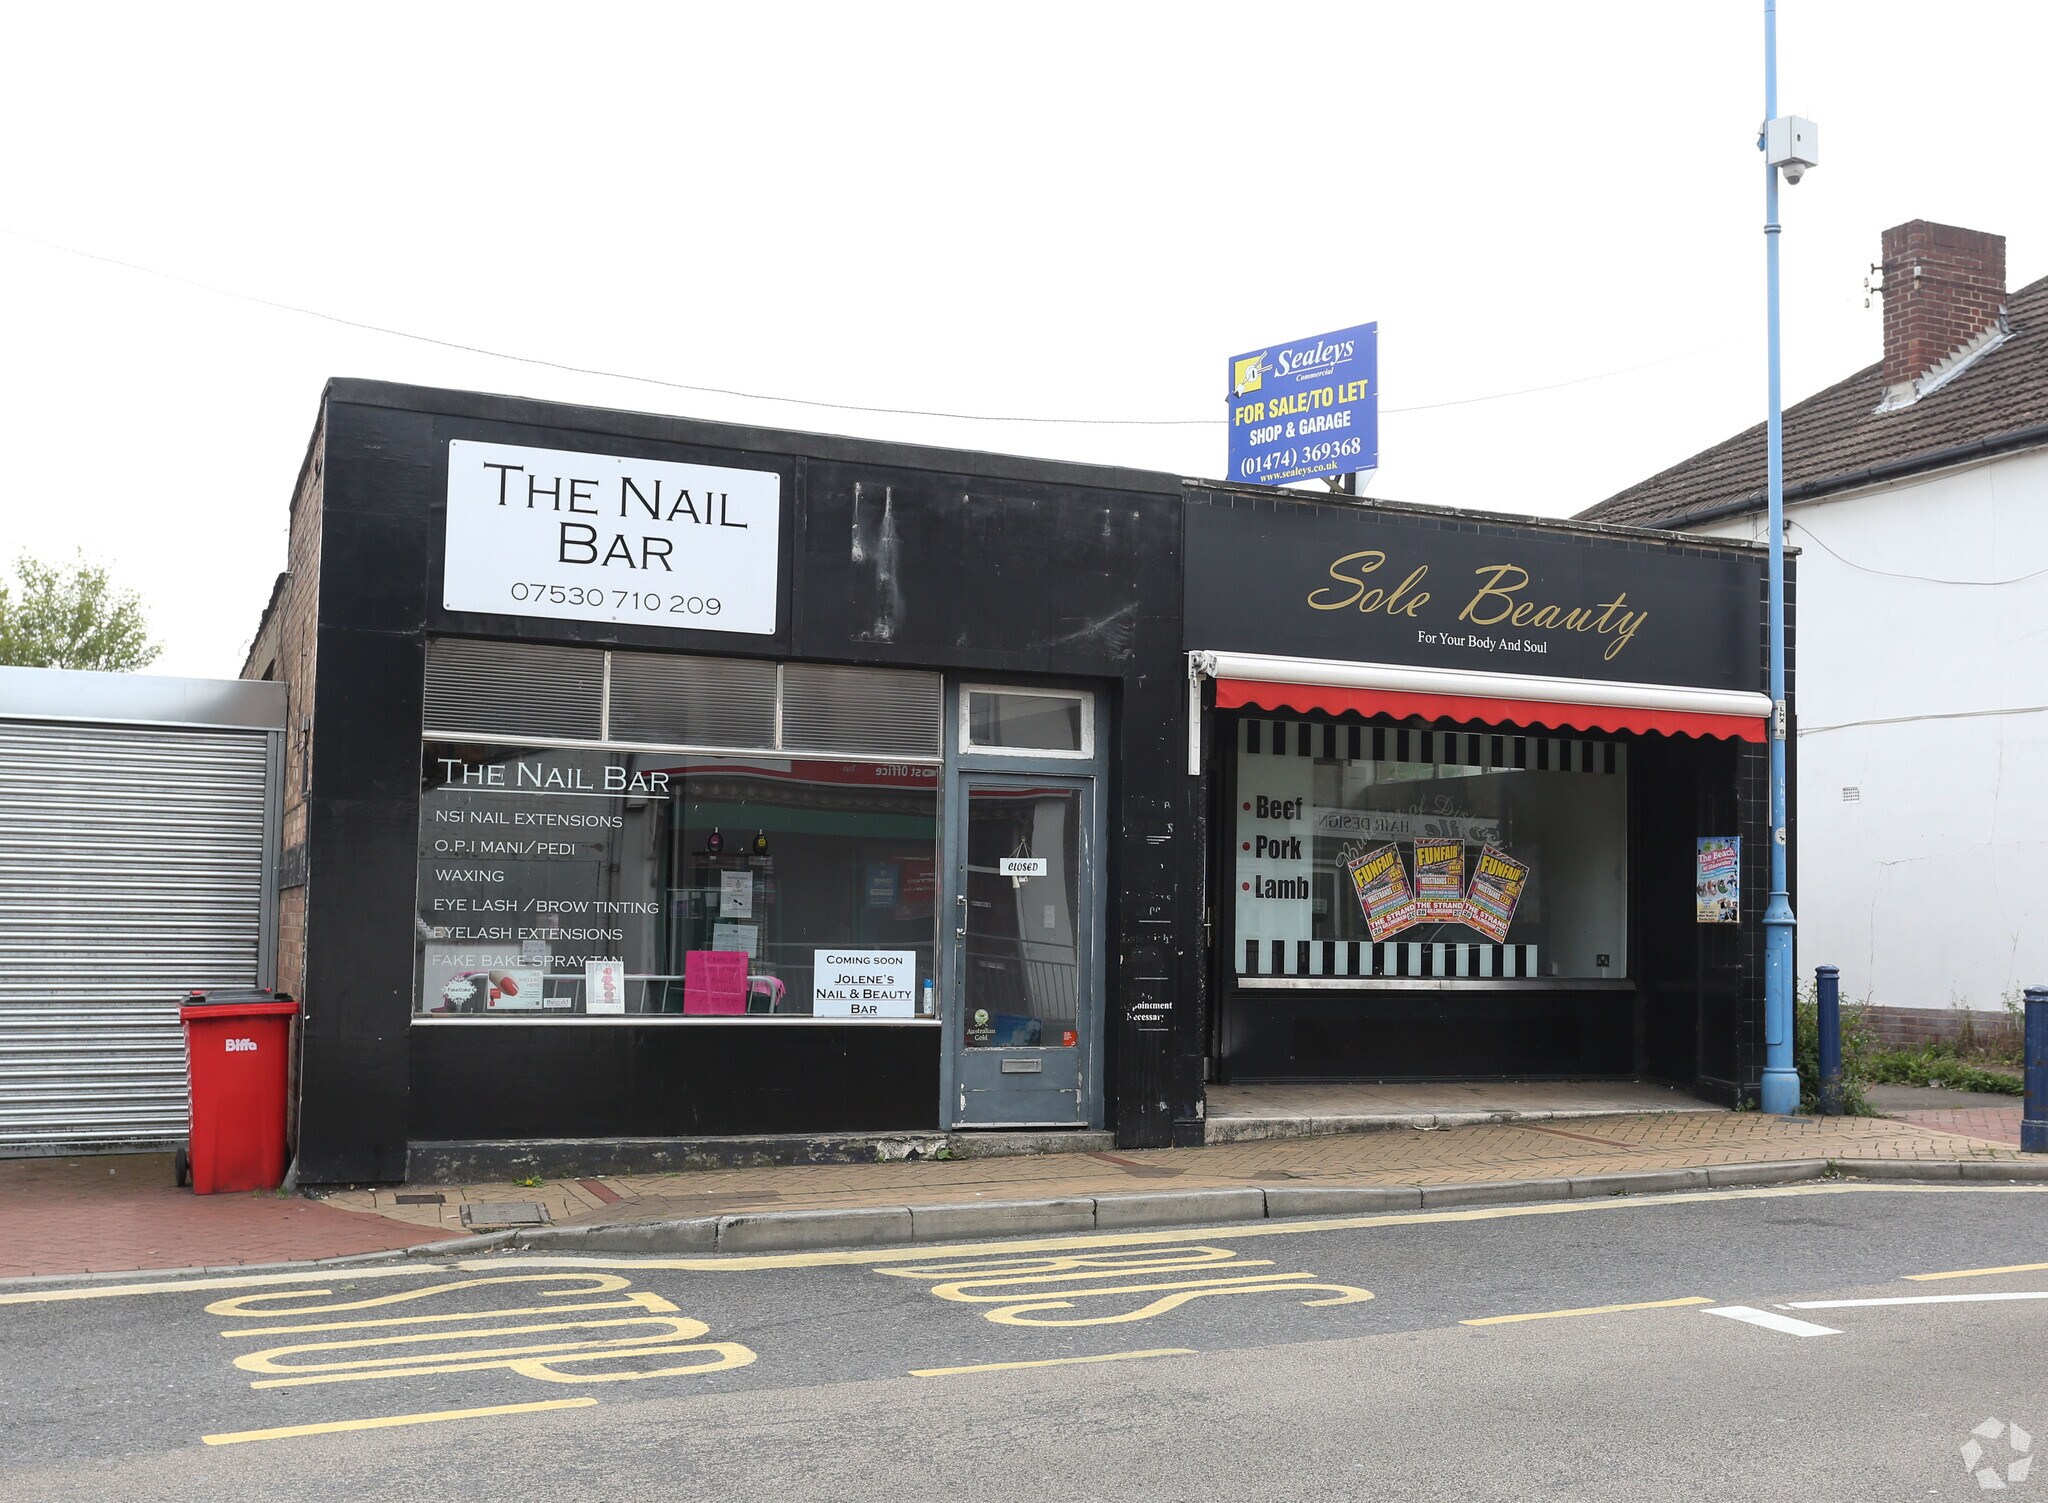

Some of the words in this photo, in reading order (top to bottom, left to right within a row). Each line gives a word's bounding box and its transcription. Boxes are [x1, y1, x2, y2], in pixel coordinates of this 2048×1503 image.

[1273, 340, 1355, 378] Sealeys
[1296, 367, 1334, 382] Commercial
[1235, 402, 1265, 427] FOR
[1269, 387, 1334, 418] SALE/TO
[1338, 379, 1368, 404] LET
[1249, 424, 1283, 446] SHOP
[1285, 421, 1296, 439] &
[1299, 410, 1352, 436] GARAGE
[1240, 448, 1297, 478] (01474)
[1301, 437, 1361, 464] 369368
[1260, 460, 1338, 483] www.sealeys.co.uk
[483, 461, 600, 516] THE
[619, 476, 748, 530] NAIL
[558, 521, 674, 572] BAR
[511, 582, 604, 607] 07530
[611, 589, 661, 611] 710
[669, 594, 721, 616] 209
[1307, 550, 1431, 617] Sole
[1458, 563, 1648, 661] Beauty
[1418, 630, 1437, 644] For
[1440, 632, 1465, 646] Your
[1468, 635, 1497, 652] Body
[1498, 638, 1521, 651] And
[1523, 640, 1547, 653] Soul
[437, 757, 506, 786] THE
[517, 761, 594, 790] NAIL
[603, 765, 669, 793] BAR
[435, 810, 464, 823] NSI
[470, 811, 510, 825] NAIL
[514, 812, 623, 828] EXTENSIONS
[1256, 795, 1303, 820] Beef
[434, 839, 475, 852] O.P.I
[480, 840, 575, 855] MANI/PEDI
[1256, 834, 1302, 859] Pork
[1416, 845, 1458, 866] FUNFAIR
[1698, 853, 1712, 863] The
[1713, 847, 1735, 860] Beach
[435, 869, 505, 882] WAXING
[1007, 862, 1039, 872] CLOSED
[1354, 852, 1394, 888] FUNFAIR
[1480, 855, 1521, 880] FUNFAIR
[1255, 874, 1309, 900] Lamb
[434, 898, 467, 911] EYE
[472, 899, 517, 912] LASH
[593, 901, 659, 914] TINTING
[1370, 918, 1385, 929] THE
[1387, 904, 1415, 921] STRAND
[1465, 902, 1479, 914] THE
[1479, 912, 1507, 929] STRAND
[433, 926, 512, 940] EYELASH
[517, 927, 623, 941] EXTENSIONS
[432, 954, 476, 967] FAKE
[481, 954, 526, 967] BAKE
[532, 955, 587, 967] SPRAY
[826, 955, 871, 965] COMING
[873, 957, 903, 965] SOON
[834, 974, 895, 984] JOLENE'S
[816, 988, 847, 999] NAIL
[849, 988, 860, 999] &
[863, 988, 912, 999] BEAUTY
[850, 1004, 878, 1014] BAR
[225, 1038, 257, 1052] Biffa
[873, 1245, 1375, 1327] BUS
[204, 1272, 757, 1390] STOP
